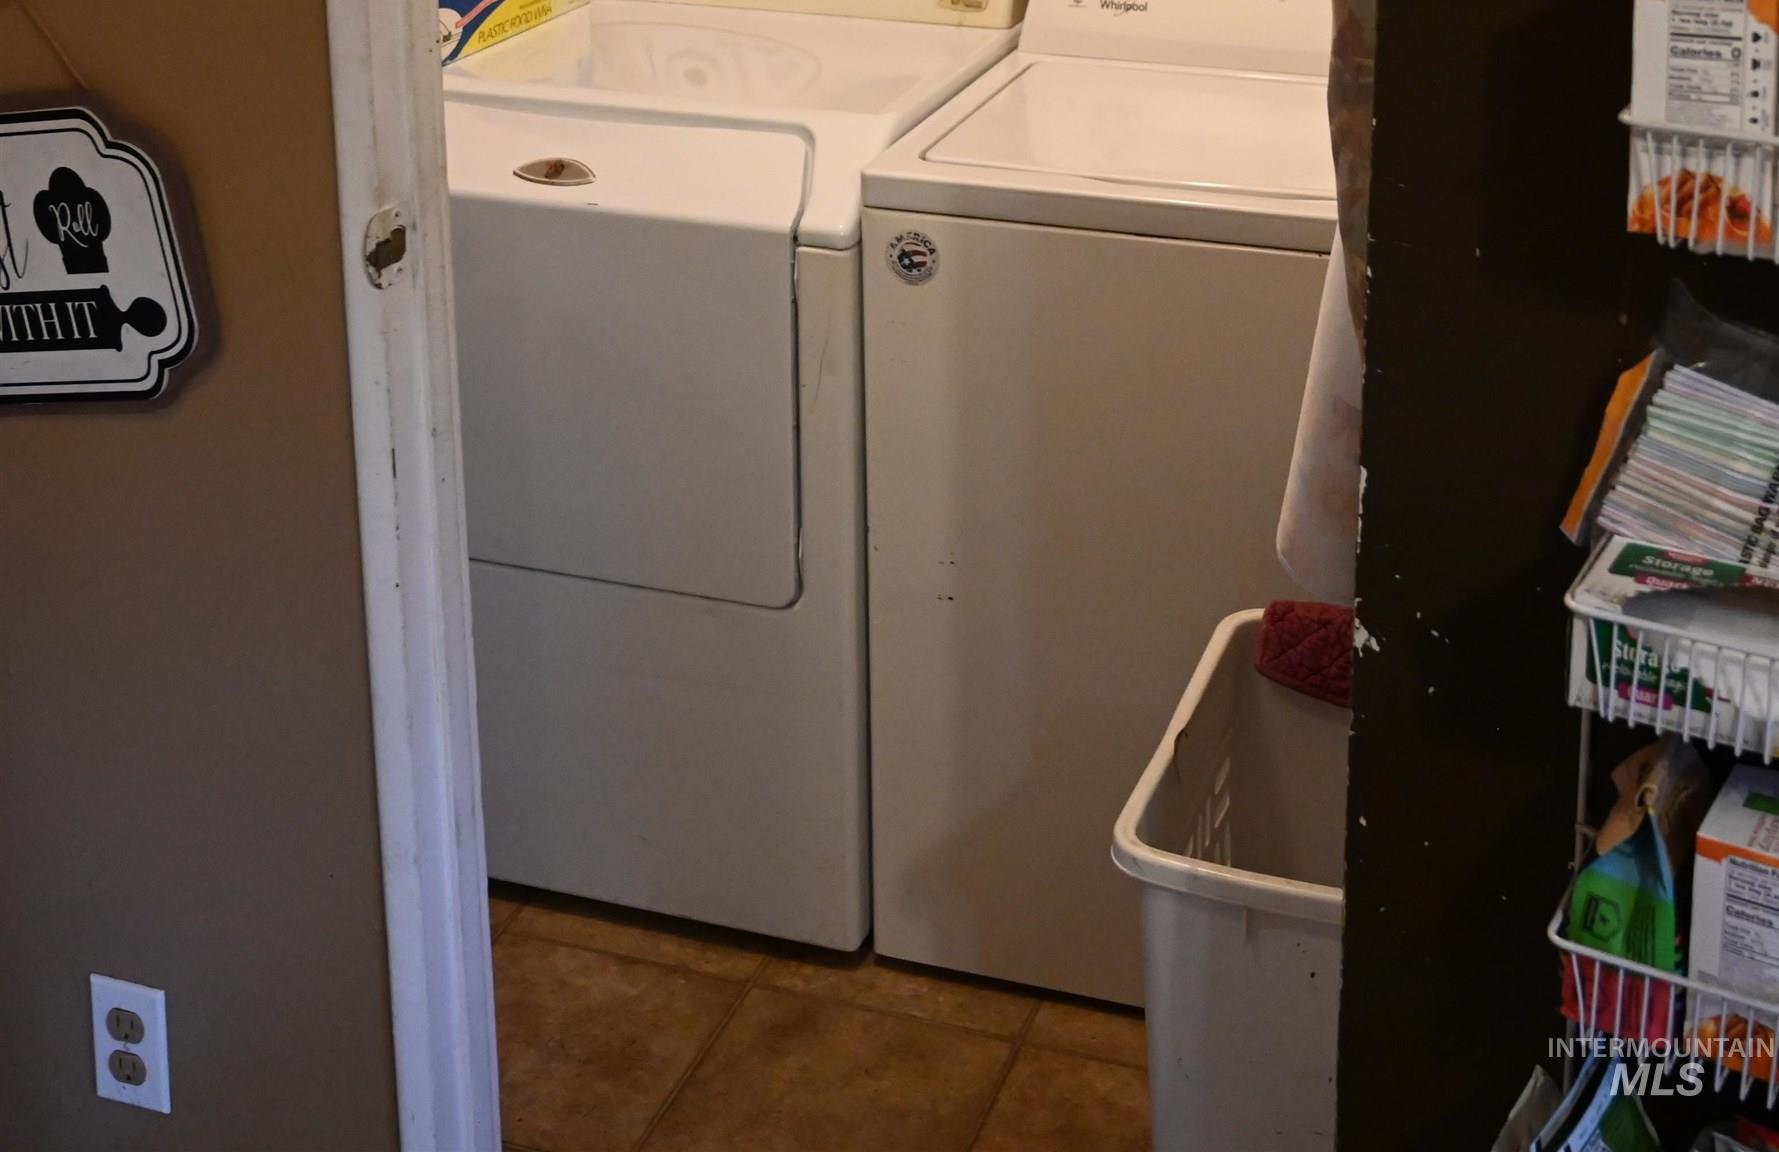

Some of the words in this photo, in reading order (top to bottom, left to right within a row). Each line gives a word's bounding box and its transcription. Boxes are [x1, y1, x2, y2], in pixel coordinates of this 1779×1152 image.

[1099, 0, 1148, 12] Whirlpool
[1670, 45, 1723, 59] Calories
[49, 201, 100, 248] Roll
[889, 230, 937, 256] AMERICA
[0, 301, 59, 342] ITH
[65, 301, 99, 341] IT
[1641, 555, 1716, 578] Storage
[1725, 905, 1774, 928] Calories
